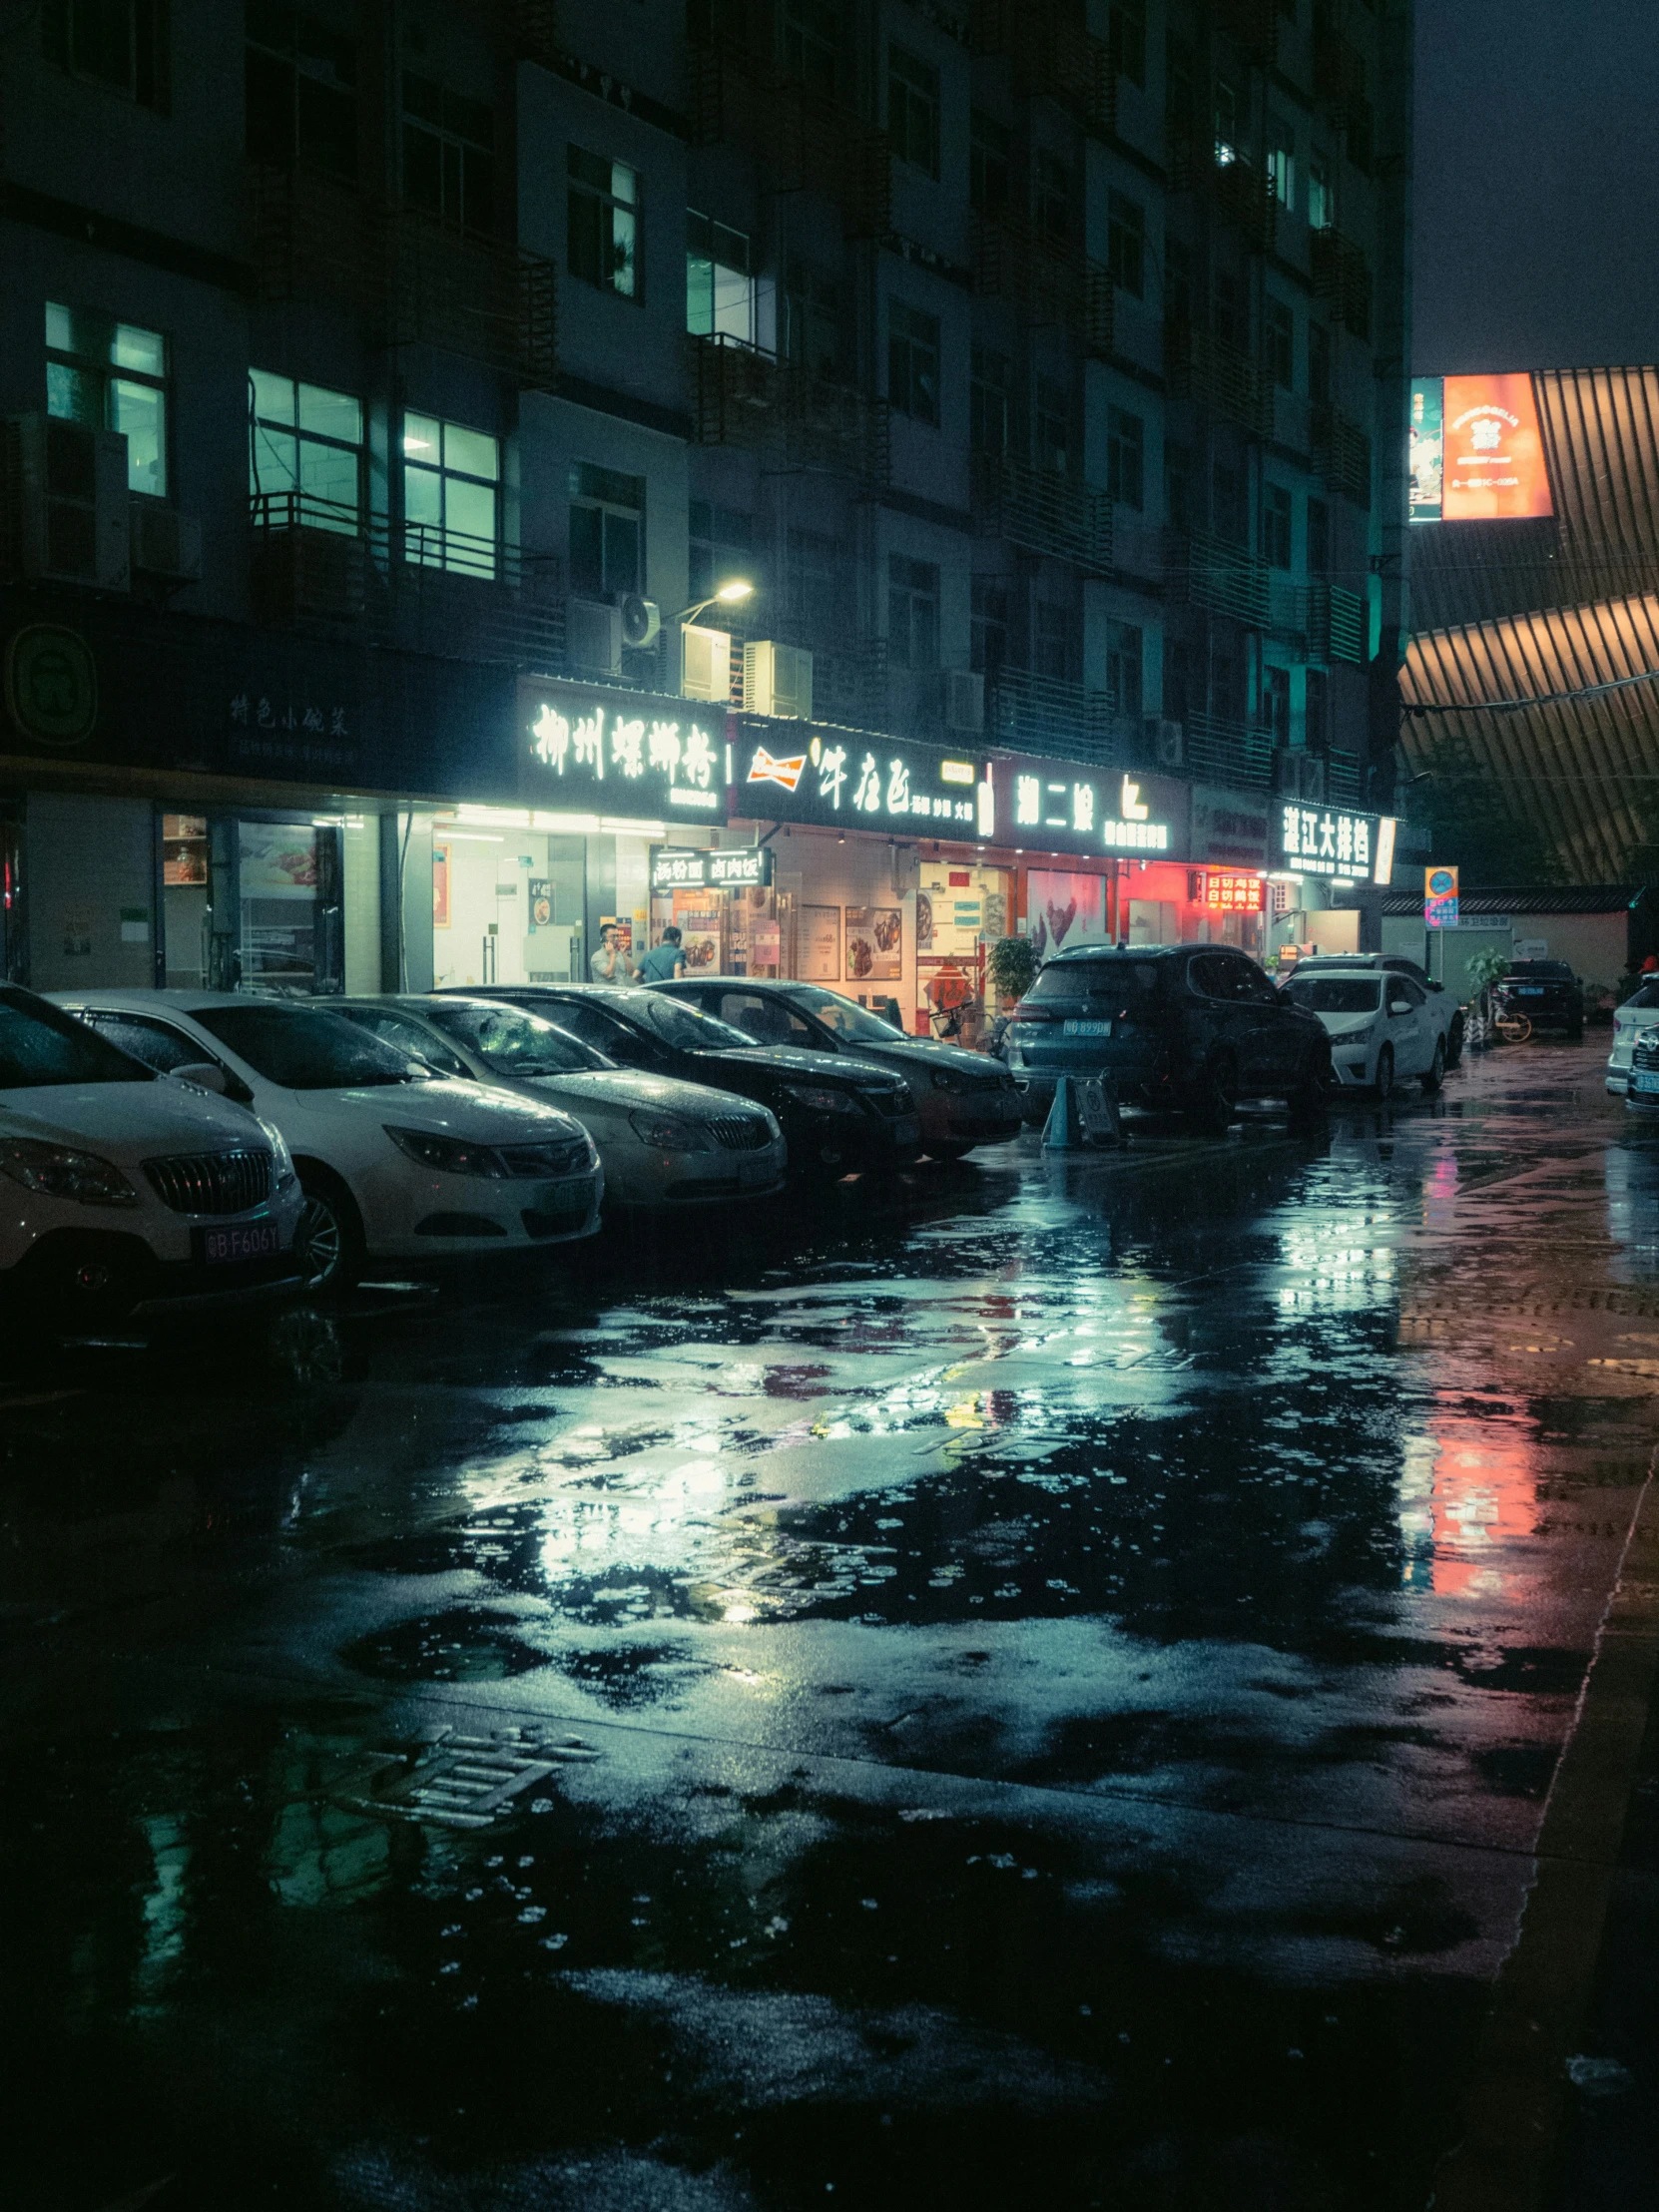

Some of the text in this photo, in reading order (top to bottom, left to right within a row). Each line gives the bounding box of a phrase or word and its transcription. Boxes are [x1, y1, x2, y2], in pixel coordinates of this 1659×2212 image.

[1284, 807, 1369, 863] 湛江大排档
[711, 857, 759, 878] 卤肉饭
